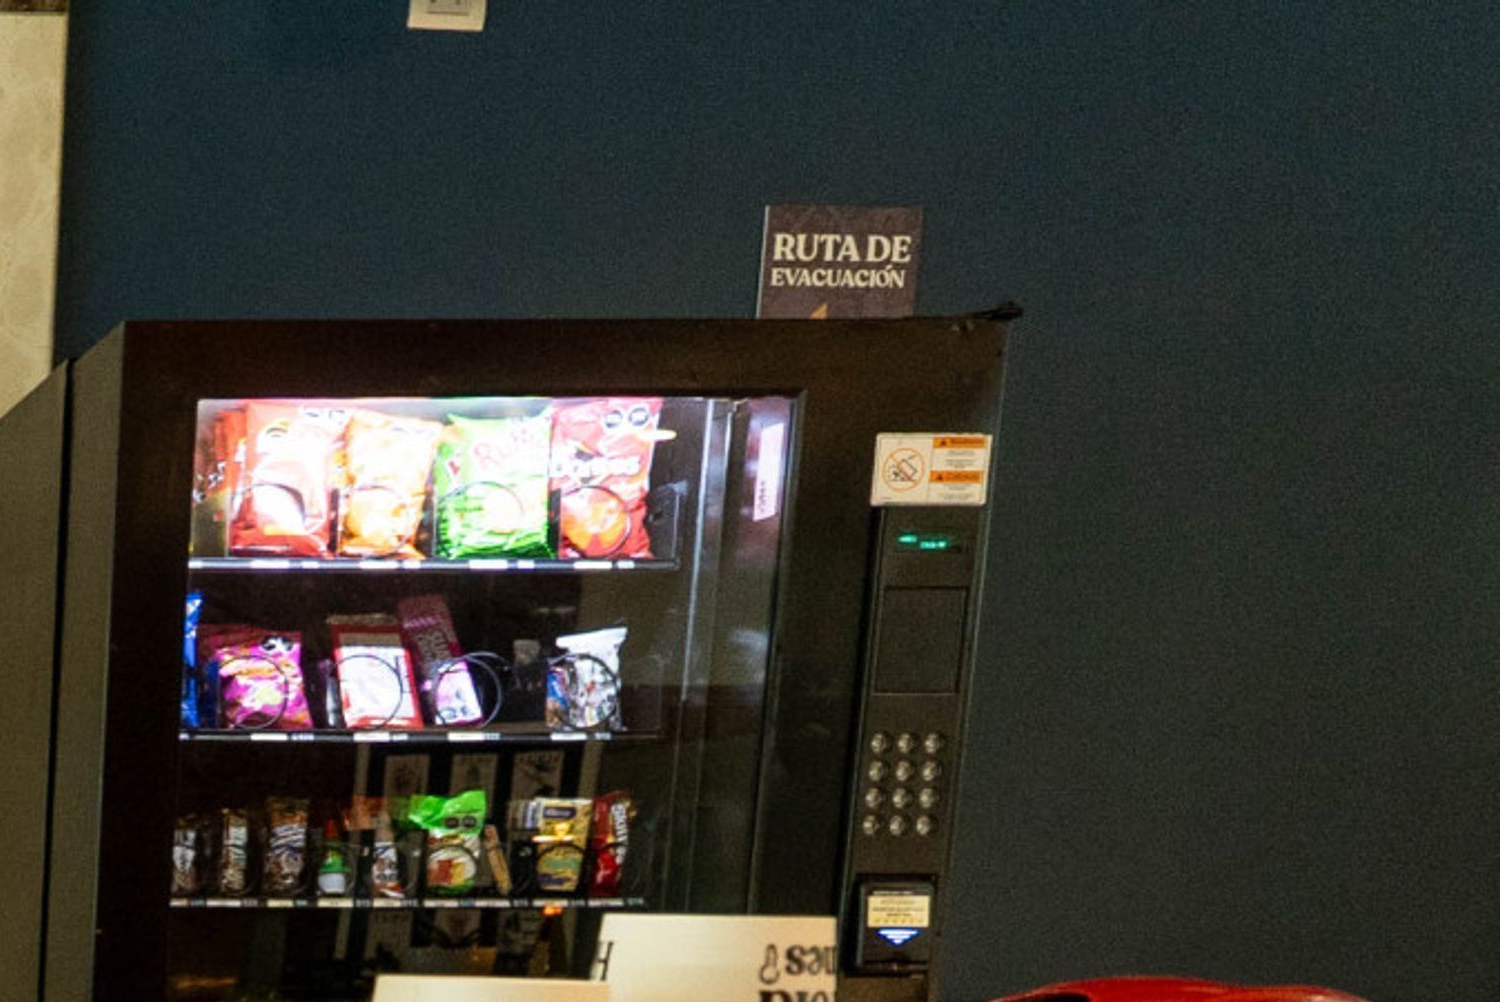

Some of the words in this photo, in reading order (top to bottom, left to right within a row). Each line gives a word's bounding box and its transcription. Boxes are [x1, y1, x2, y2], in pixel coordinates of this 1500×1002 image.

[772, 233, 861, 263] RUTA
[865, 235, 913, 264] DE
[770, 264, 906, 289] EVACUACIÓN
